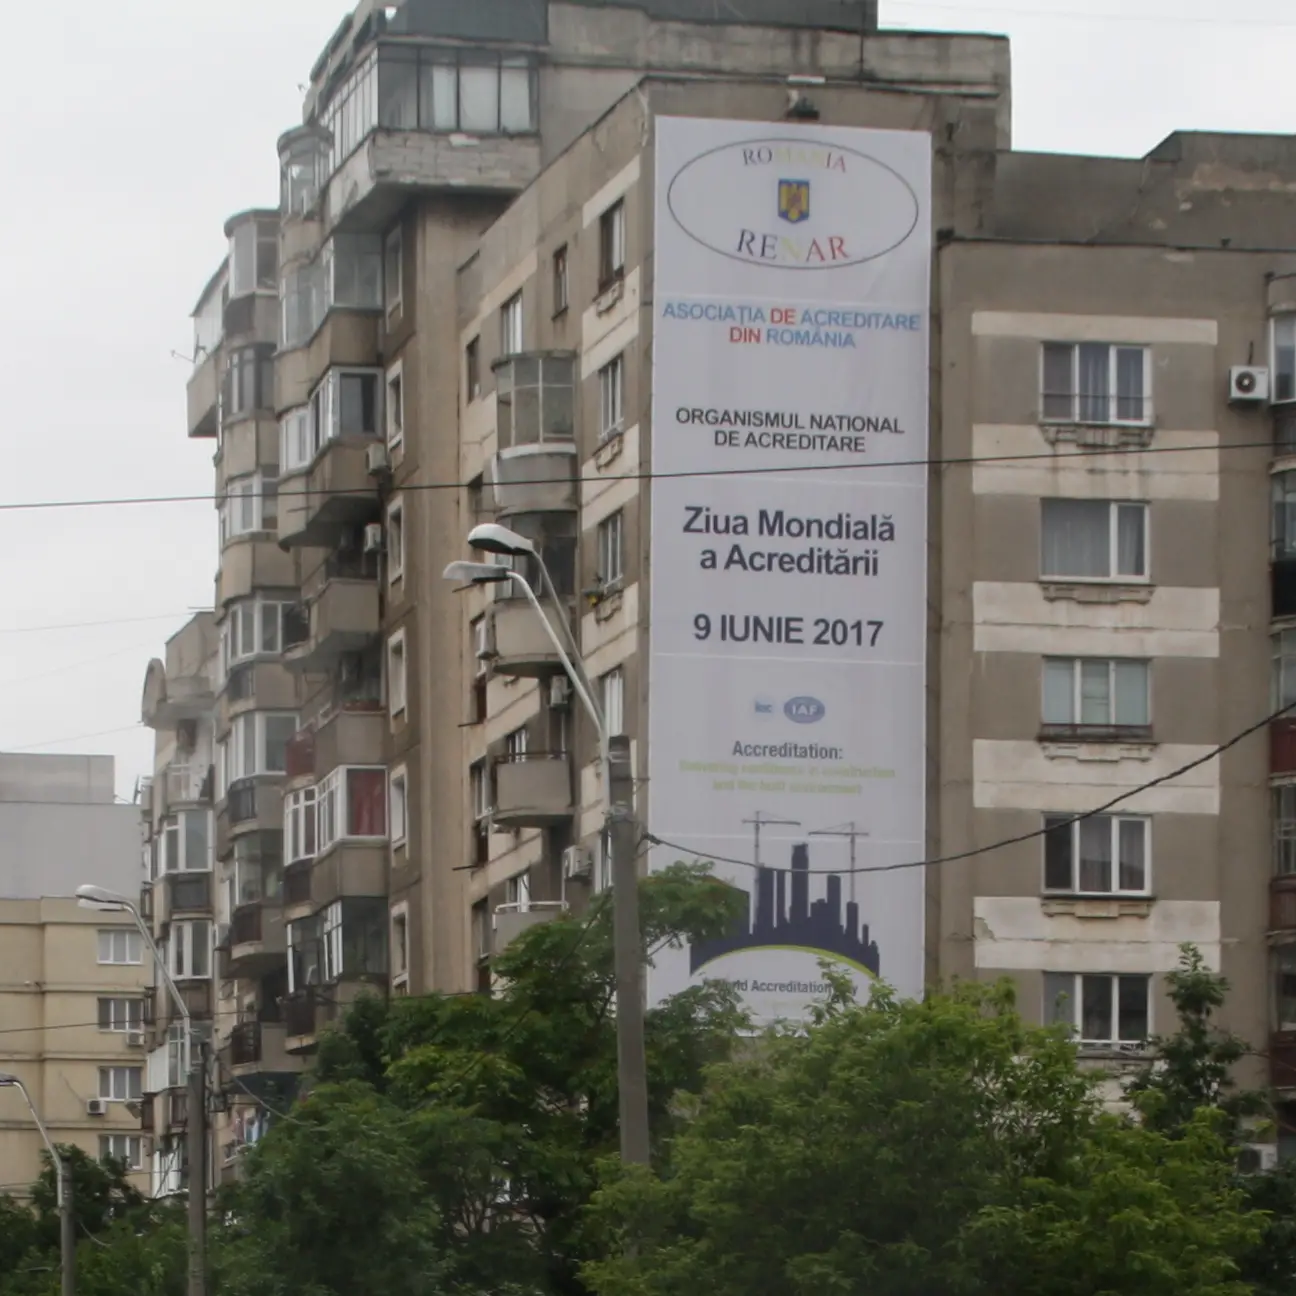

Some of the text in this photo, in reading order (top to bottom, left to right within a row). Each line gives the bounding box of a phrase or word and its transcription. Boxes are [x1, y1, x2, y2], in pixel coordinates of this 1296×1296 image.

[736, 228, 851, 263] RENAR
[770, 307, 797, 326] DE
[800, 310, 921, 331] ACREDITARE
[729, 326, 856, 349] DIN ROMÂNIA
[675, 407, 905, 434] ORGANISMUL NATIONAL
[714, 430, 866, 453] DE ACREDITARE
[682, 505, 895, 542] Ziua Mondială
[700, 544, 879, 577] a Acreditării
[693, 613, 885, 648] 9 IUNIE 2017
[791, 704, 818, 717] IAF
[732, 740, 843, 761] Accreditation:
[751, 979, 832, 995] Accreditation
